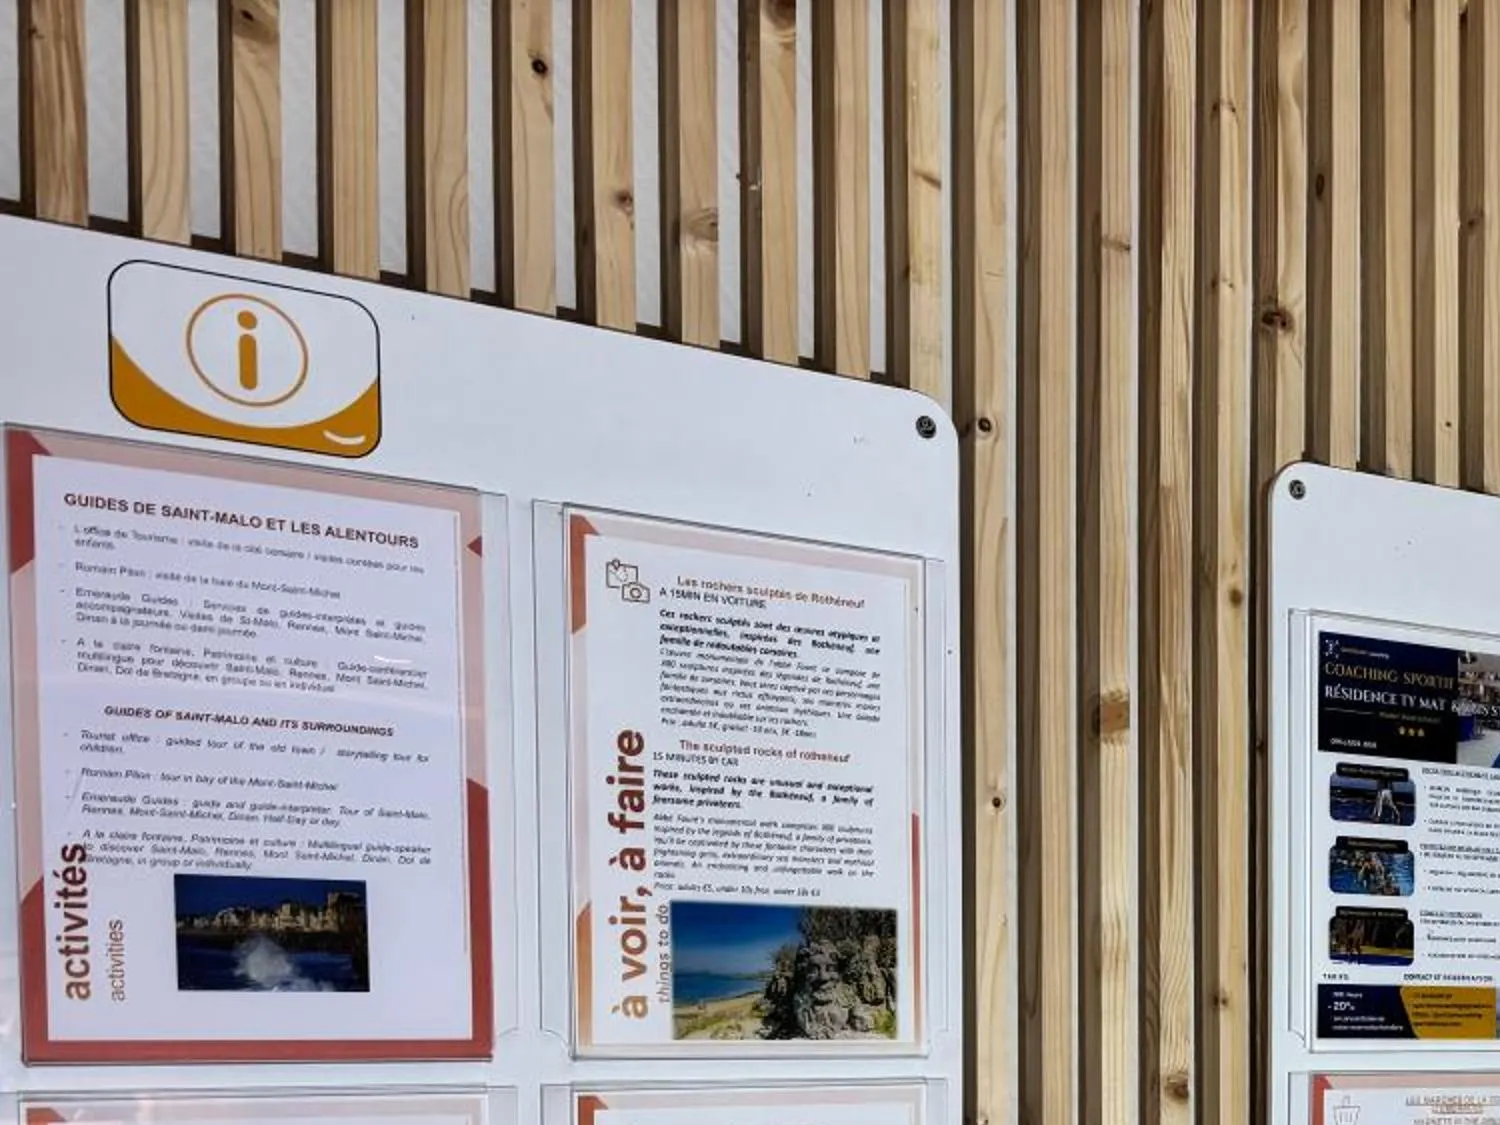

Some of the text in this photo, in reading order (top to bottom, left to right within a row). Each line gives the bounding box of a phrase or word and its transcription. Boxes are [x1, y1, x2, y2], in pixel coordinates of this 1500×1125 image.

[64, 493, 419, 549] GUIDES DE SAINT-MALO ET LES ALENTOURS
[677, 576, 698, 587] Les
[701, 580, 743, 593] rochers
[796, 591, 808, 601] de
[1324, 661, 1398, 683] COACHING
[1324, 683, 1398, 706] RÉSIDENCE
[1400, 693, 1417, 707] TY
[104, 705, 394, 736] GUIDES OF SAINT-MALO AND ITS SURROUNDINGS
[653, 751, 664, 761] 15
[665, 753, 707, 765] MINUTES
[721, 756, 739, 767] CAR
[680, 739, 699, 750] The
[703, 743, 750, 755] sculpted
[753, 747, 783, 758] rocks
[785, 749, 797, 759] of
[653, 769, 679, 779] These
[683, 773, 720, 784] sculpted
[723, 775, 747, 784] rocks
[605, 729, 653, 1018] à voir, à faire
[52, 843, 91, 1002] activités
[655, 904, 669, 925] do
[658, 930, 670, 947] to
[105, 919, 125, 1002] activities
